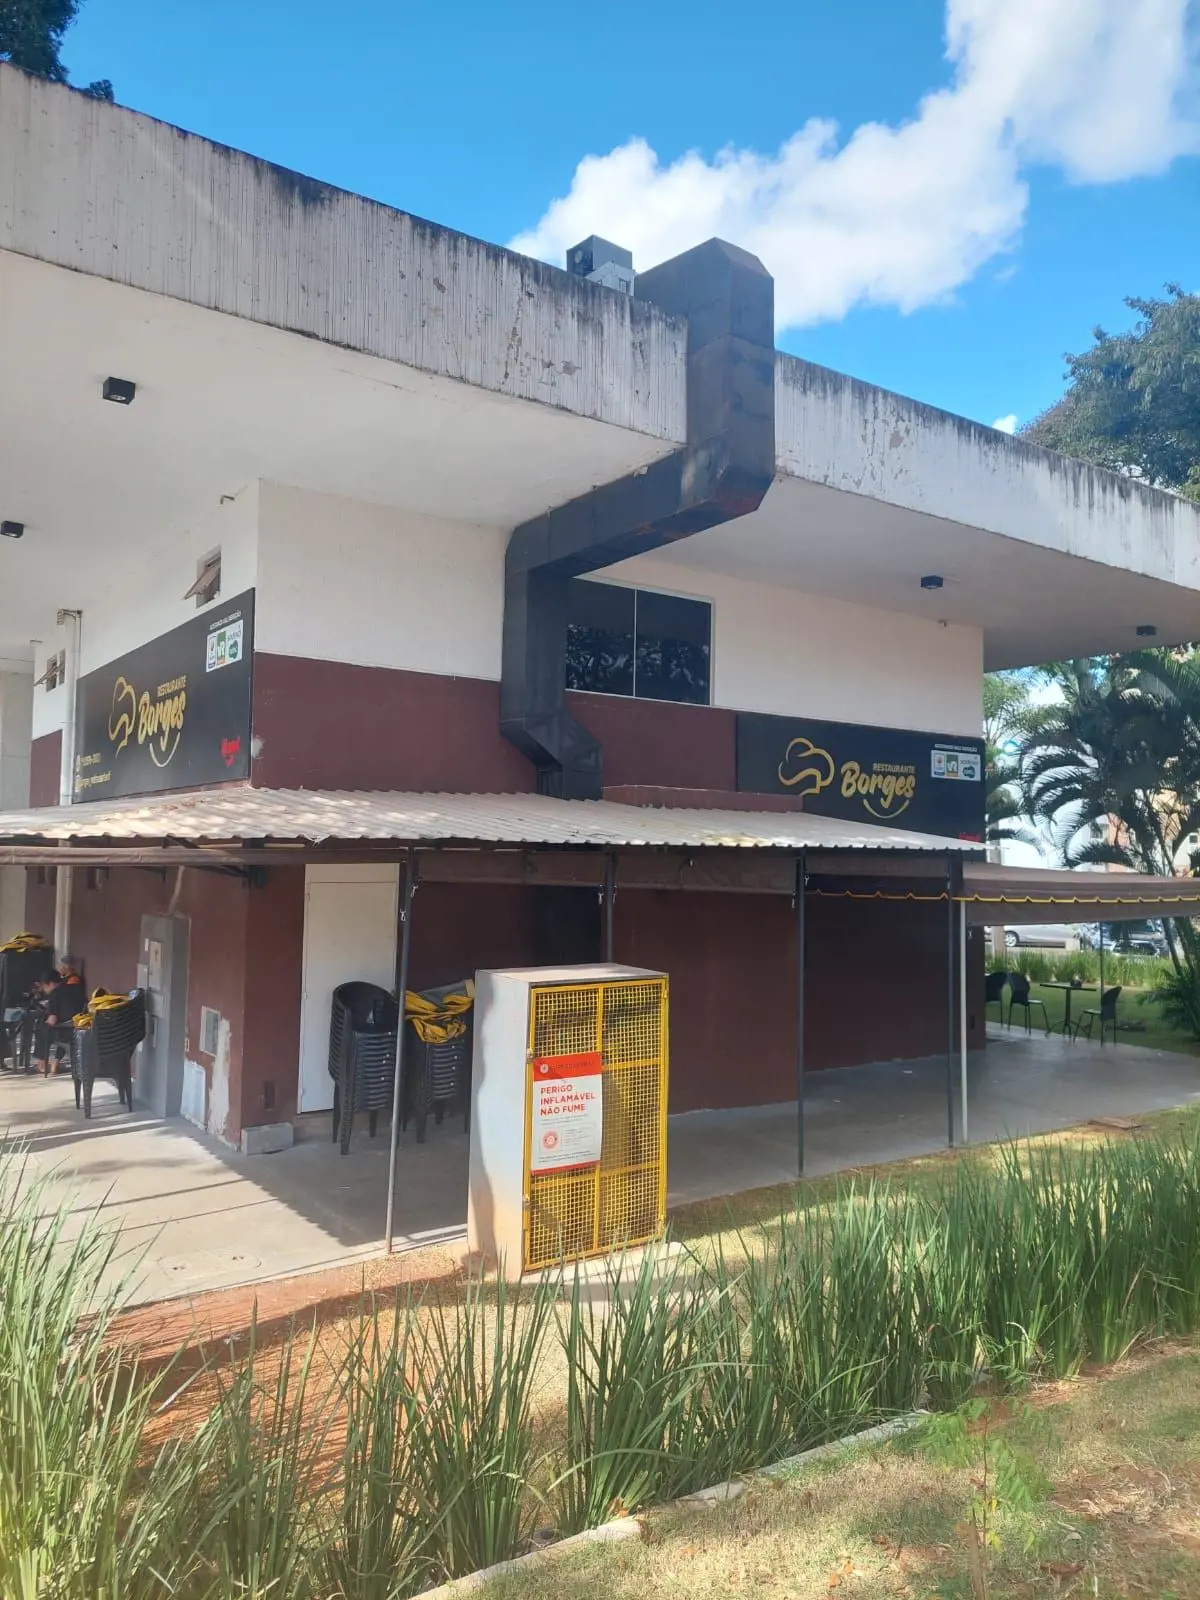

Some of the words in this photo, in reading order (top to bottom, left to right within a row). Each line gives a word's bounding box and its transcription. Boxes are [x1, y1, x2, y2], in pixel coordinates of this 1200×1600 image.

[157, 675, 186, 697] RESTAURANTE
[138, 691, 186, 751] Borges
[873, 763, 915, 773] RESTAURANTE
[841, 761, 915, 808] Borges
[540, 1084, 573, 1094] PERIGO
[540, 1092, 596, 1105] INFLAMÁVEL
[540, 1105, 560, 1116] NÃO
[562, 1104, 586, 1113] FUME
